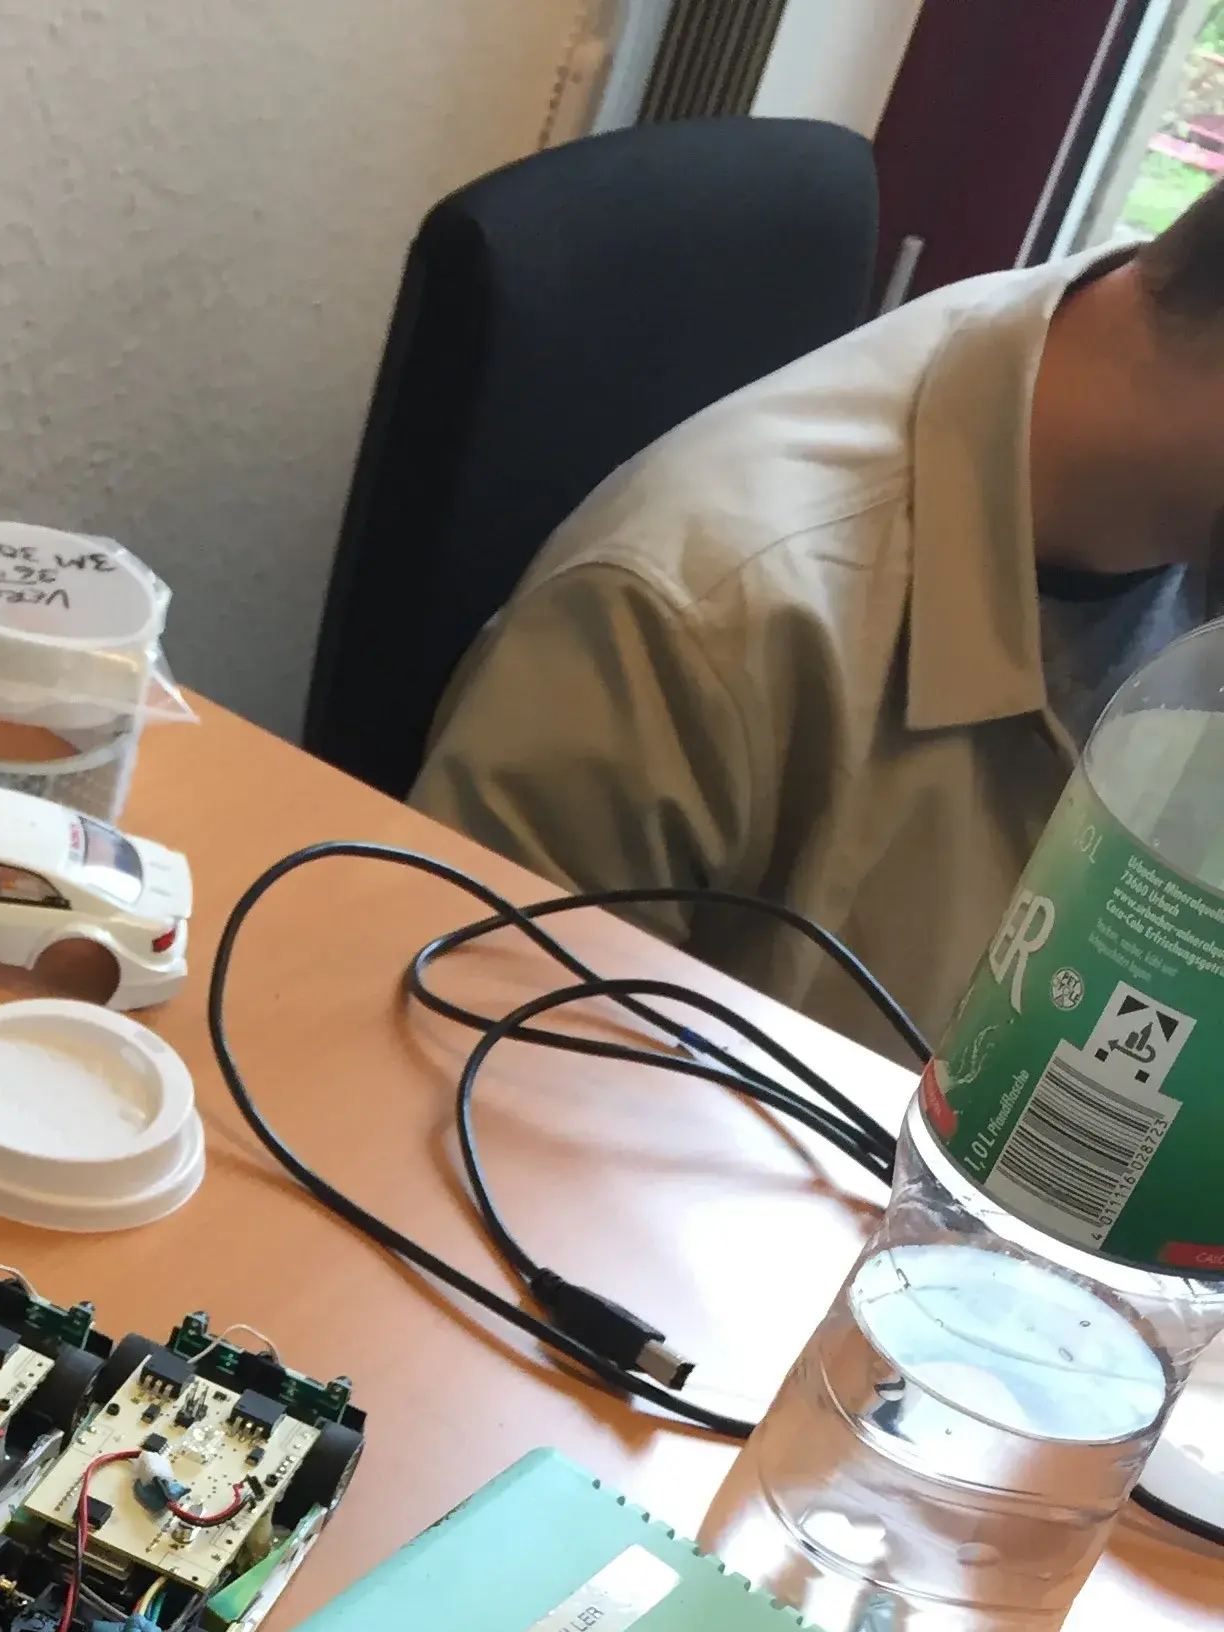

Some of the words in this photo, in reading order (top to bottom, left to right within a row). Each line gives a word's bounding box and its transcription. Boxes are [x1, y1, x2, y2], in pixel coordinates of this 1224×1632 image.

[55, 553, 117, 572] 3M
[1128, 854, 1164, 887] Urbacher
[1120, 869, 1149, 897] 73660
[1148, 889, 1180, 917] Urbach
[1105, 899, 1144, 933] Coca-Cola
[964, 1140, 988, 1171] 1,0
[977, 1132, 995, 1149] L
[986, 1069, 1030, 1137] Pfandflasche
[1099, 1172, 1137, 1226] 011116
[1130, 1118, 1168, 1171] 028723
